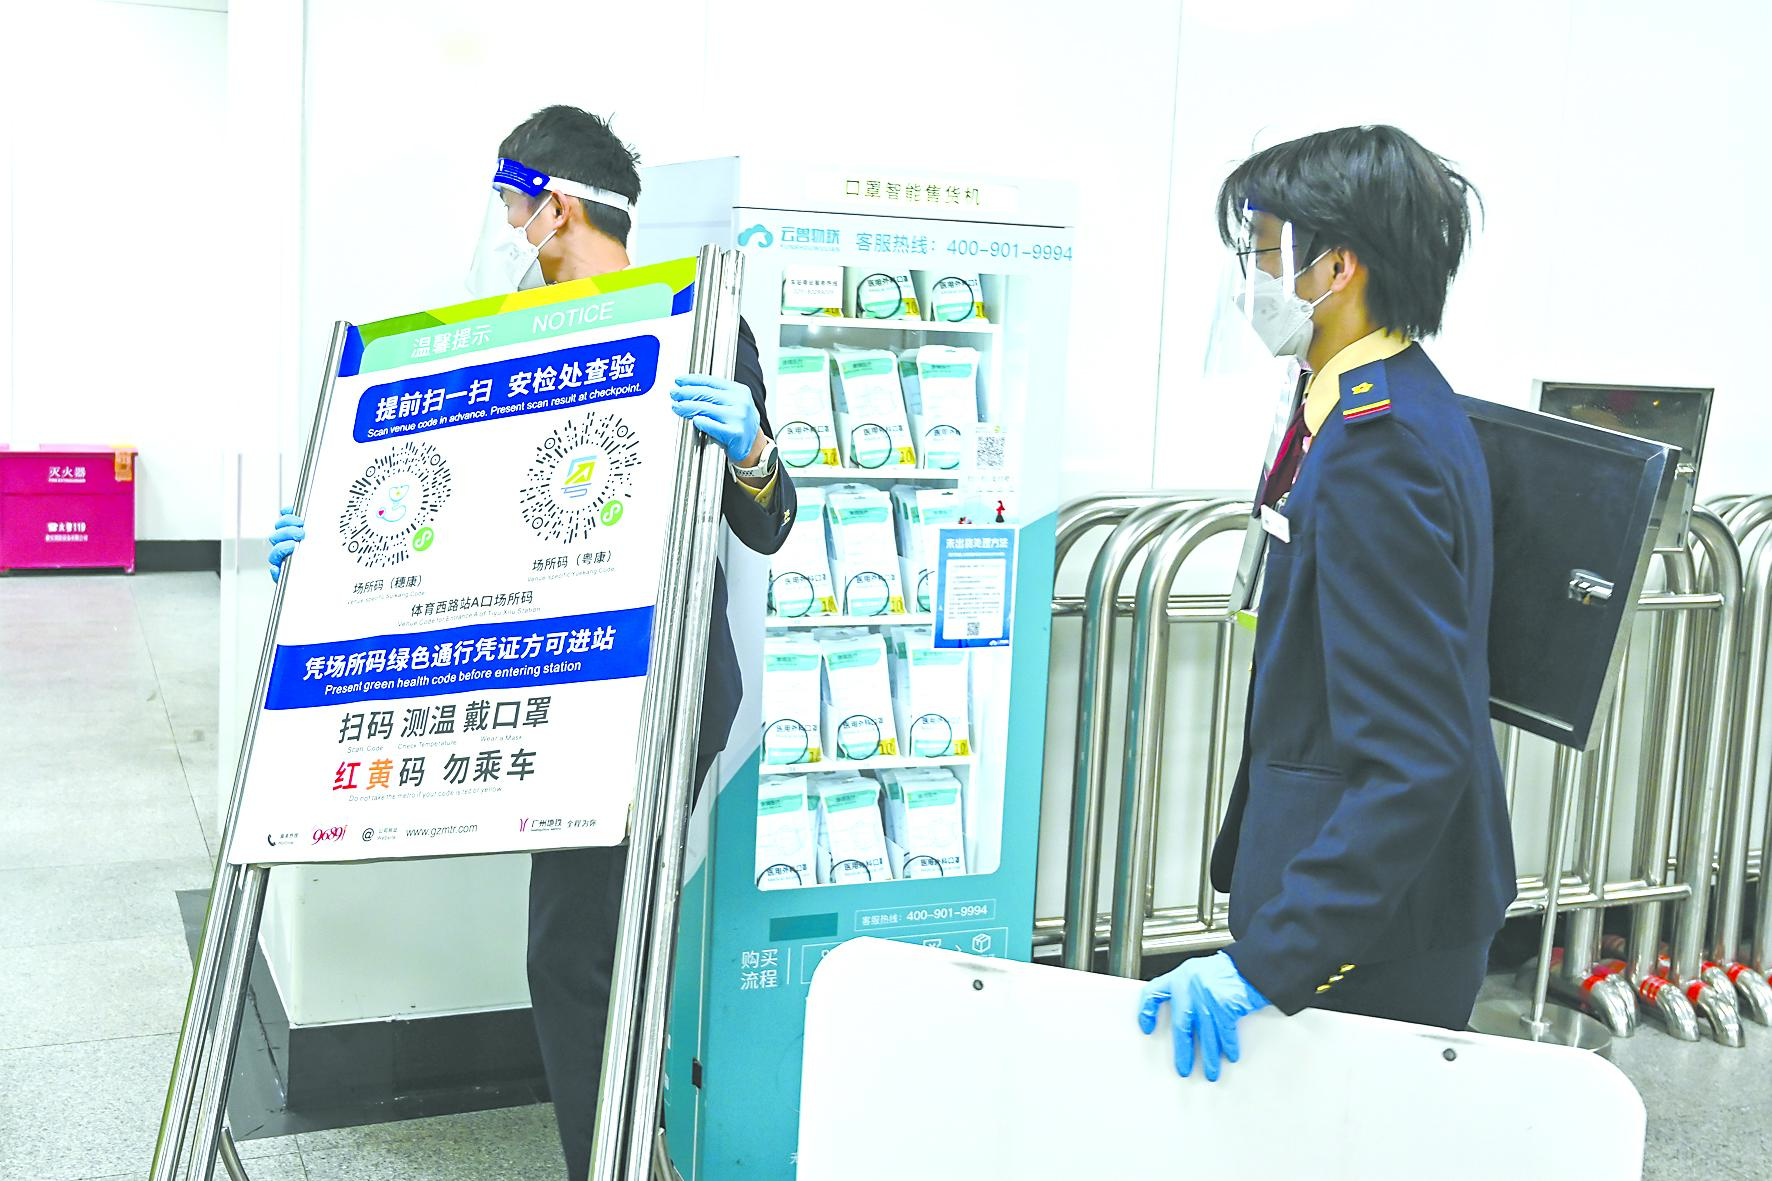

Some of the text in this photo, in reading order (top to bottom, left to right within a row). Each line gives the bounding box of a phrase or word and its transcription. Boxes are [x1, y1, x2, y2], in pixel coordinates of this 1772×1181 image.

[845, 179, 981, 206] 口罩智能售货机
[946, 240, 1073, 261] 400-901-9994
[532, 301, 615, 334] NOTICE
[410, 323, 493, 359] 温馨提示
[374, 352, 637, 423] 提前扫一扫 安检处查验
[367, 383, 643, 439] Scan venue code in advance. Present scan result at checkpoint.
[48, 466, 87, 478] 灭火器
[532, 550, 612, 572] 场所码（粤康）
[411, 590, 534, 618] 体育西路站A口场所码
[303, 625, 617, 681] 凭场所码绿色通行凭证方可进站
[324, 659, 582, 697] Present green health code before entering station
[338, 696, 552, 744] 扫码 测温 戴口罩
[332, 747, 537, 791] 红黄码 勿乘车
[406, 823, 478, 838] www.gzmtr.com
[906, 904, 988, 921] 400-901-9994
[740, 948, 779, 970] 购买
[740, 970, 779, 991] 流程
